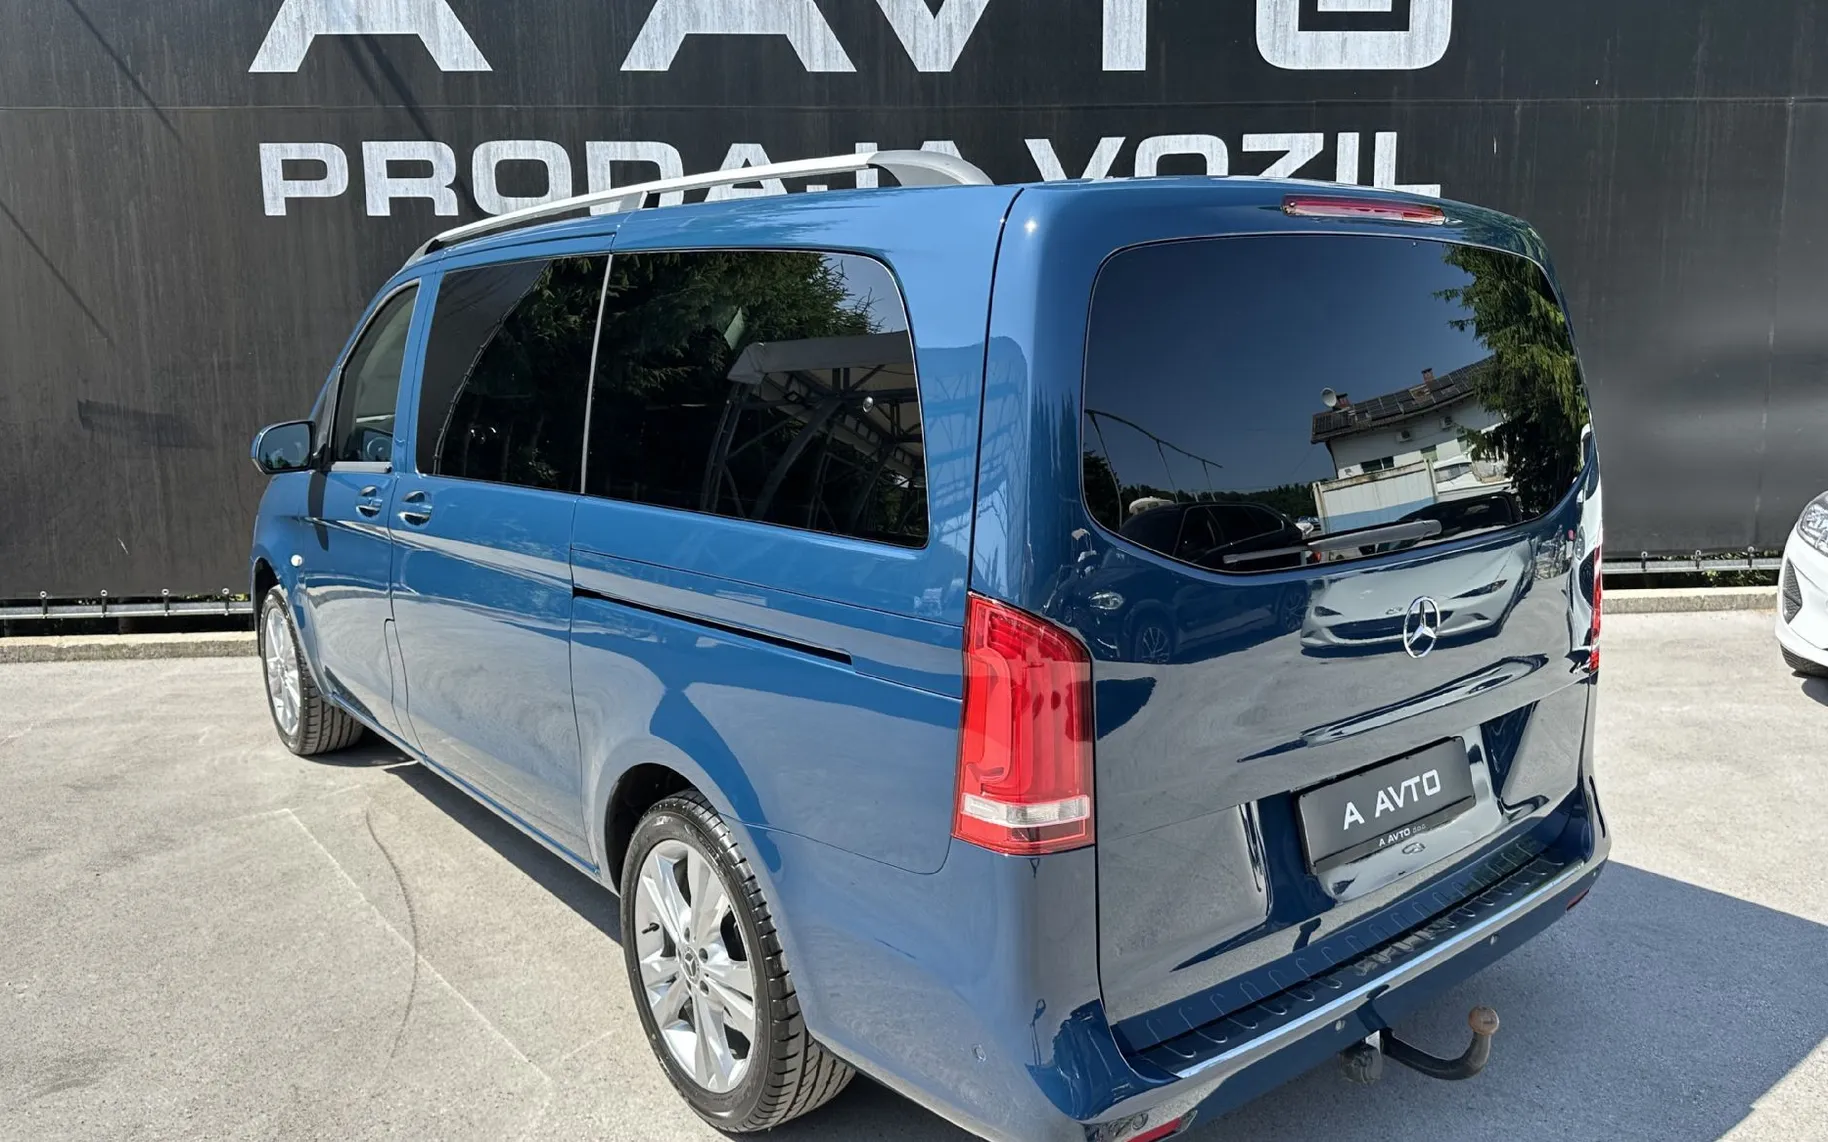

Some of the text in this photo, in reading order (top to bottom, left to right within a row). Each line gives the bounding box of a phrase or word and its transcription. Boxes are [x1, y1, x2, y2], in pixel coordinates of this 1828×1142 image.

[1343, 769, 1441, 830] A AVTO
[1379, 838, 1386, 847] A
[1387, 827, 1411, 844] AVTO
